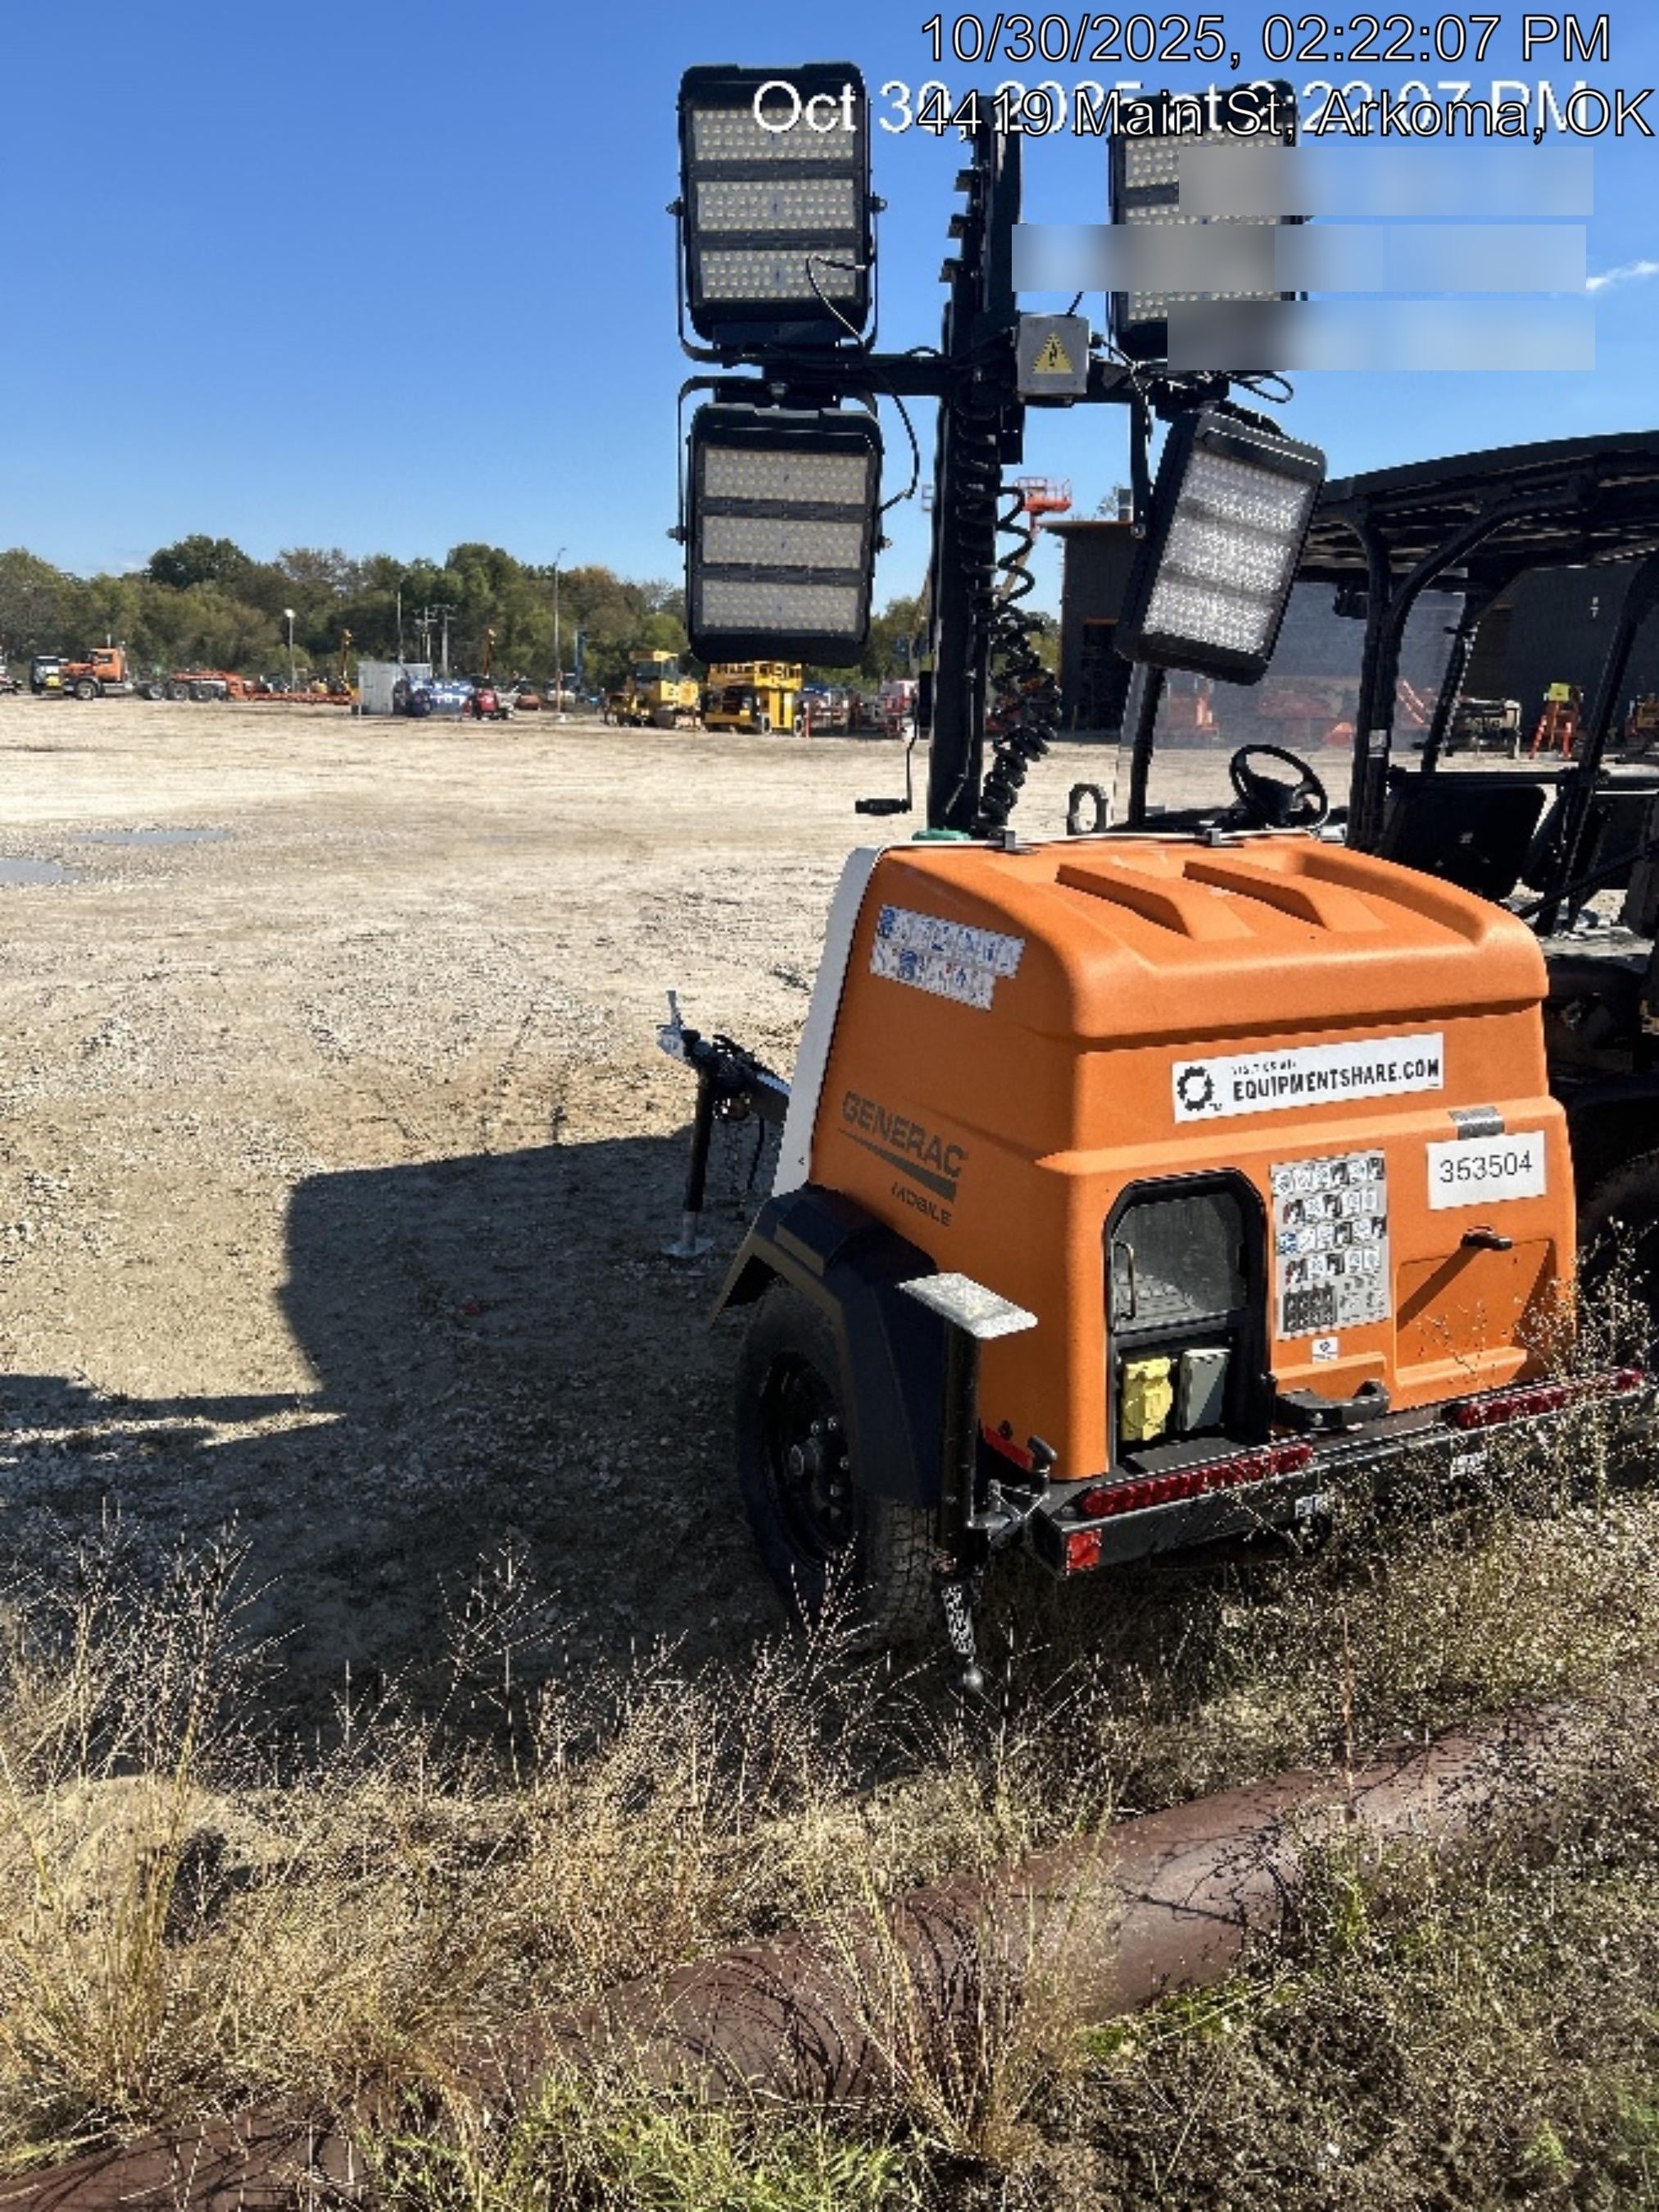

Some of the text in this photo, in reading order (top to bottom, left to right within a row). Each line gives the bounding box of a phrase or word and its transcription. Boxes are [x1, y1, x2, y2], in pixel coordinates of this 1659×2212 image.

[1232, 1058, 1439, 1101] EQUIPMENTSHARE.COM
[842, 1090, 966, 1178] GENERAC
[1439, 1149, 1533, 1183] 353504
